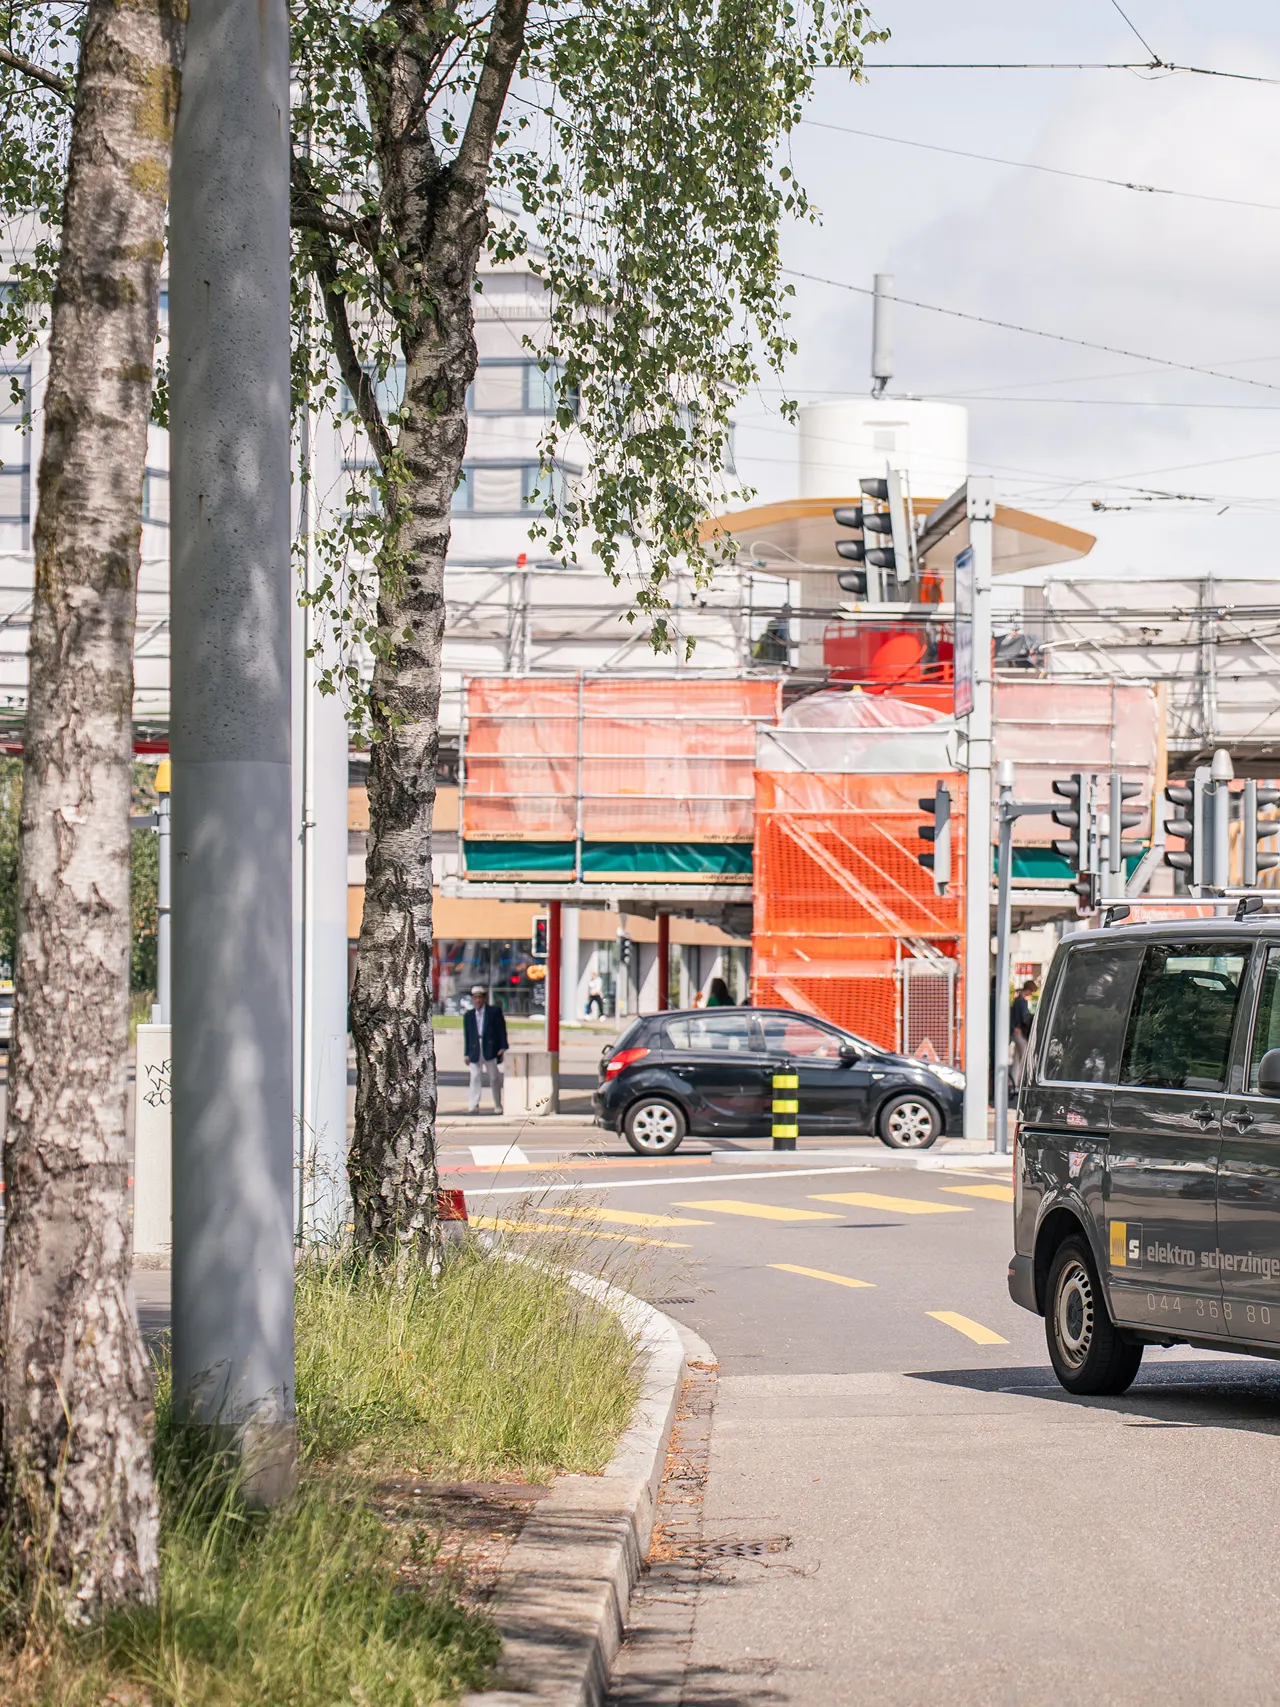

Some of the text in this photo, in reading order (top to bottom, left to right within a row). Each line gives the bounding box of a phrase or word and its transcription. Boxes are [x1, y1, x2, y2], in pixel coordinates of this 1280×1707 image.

[1147, 1242, 1196, 1266] elektro
[1147, 1293, 1183, 1314] 044
[1196, 1299, 1233, 1320] 368
[1246, 1305, 1271, 1325] 80
